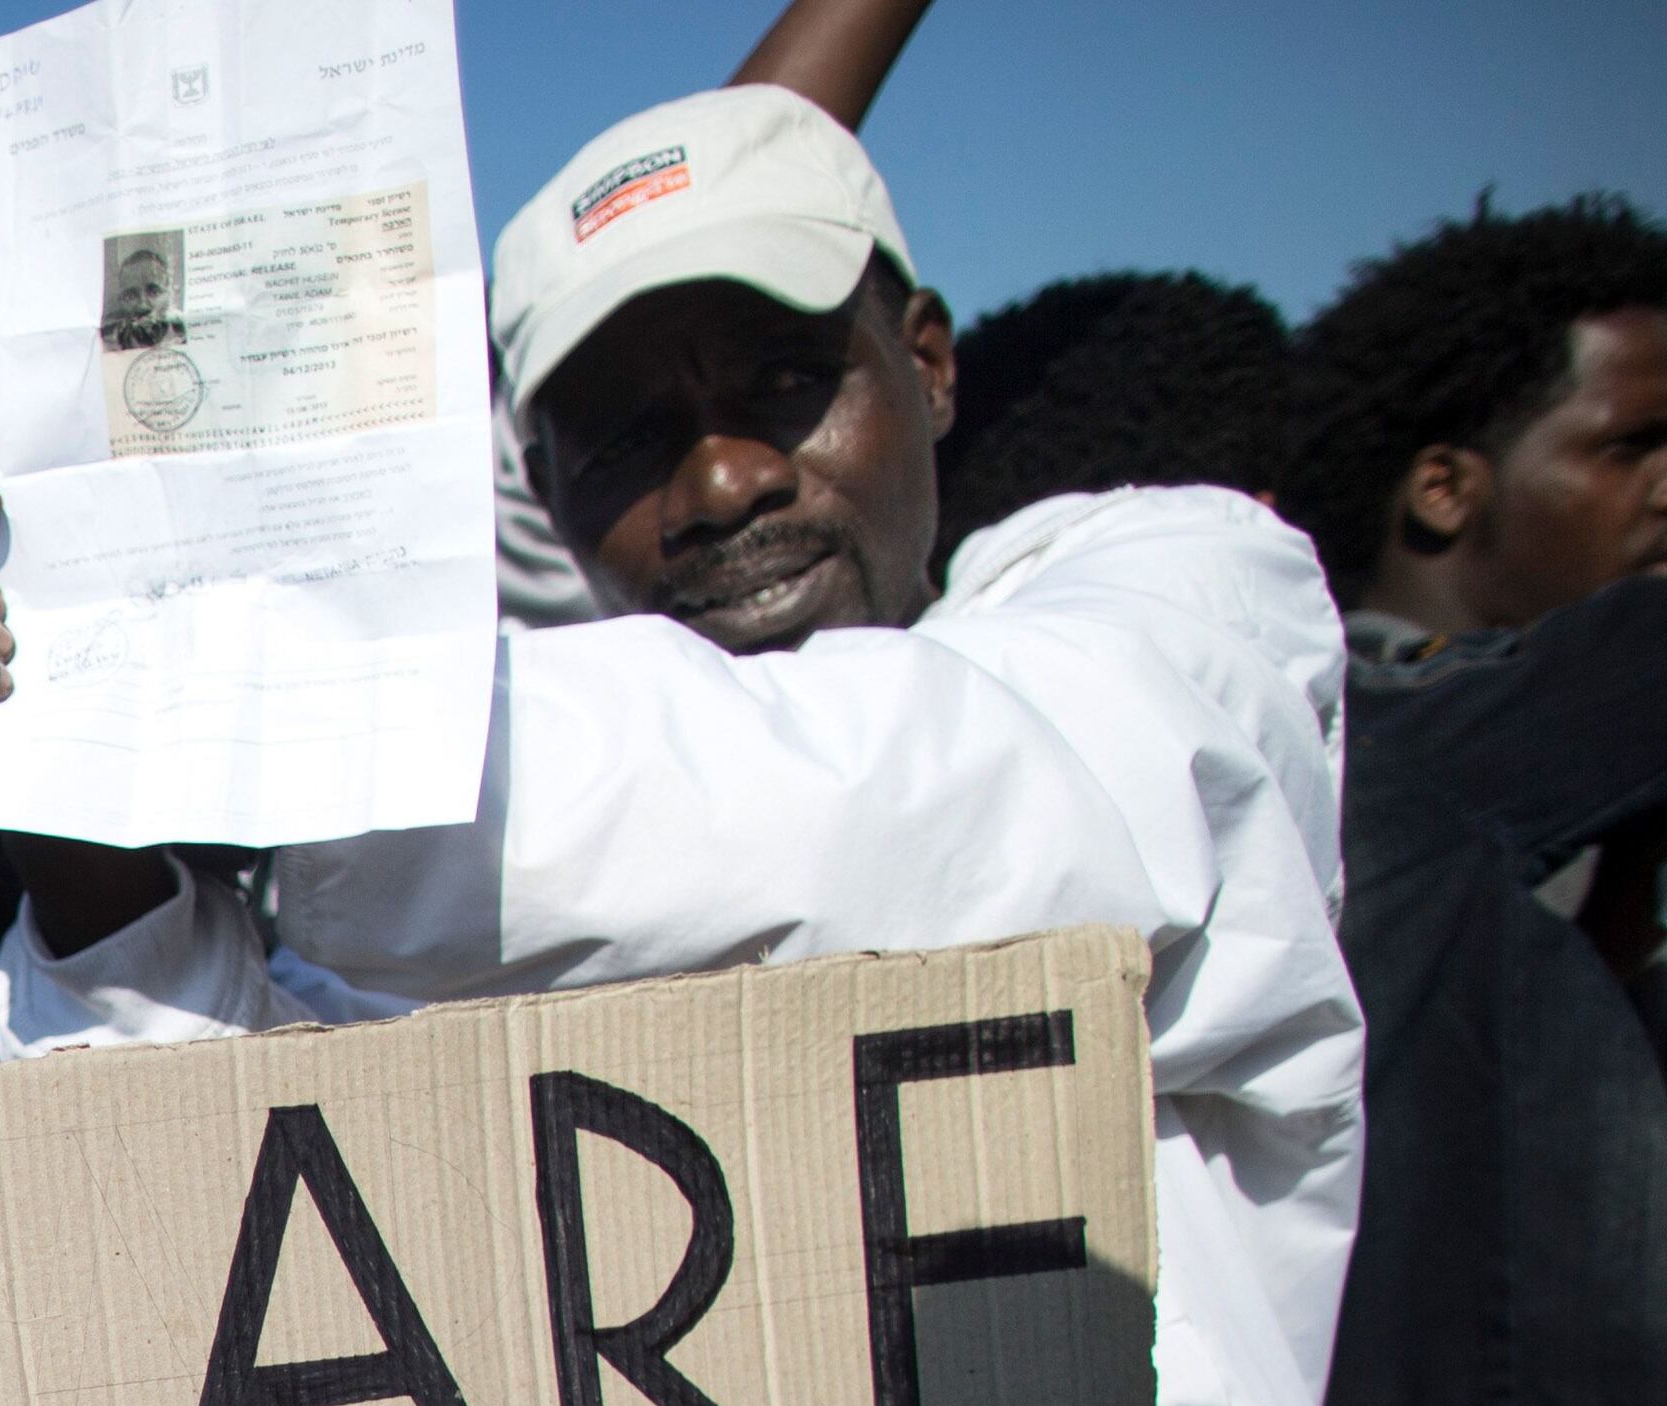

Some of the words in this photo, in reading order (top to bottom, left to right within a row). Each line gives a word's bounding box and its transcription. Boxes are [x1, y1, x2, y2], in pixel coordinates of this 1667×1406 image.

[380, 41, 426, 67] מדינת
[318, 58, 374, 80] ישראל
[251, 261, 297, 277] RELEASE
